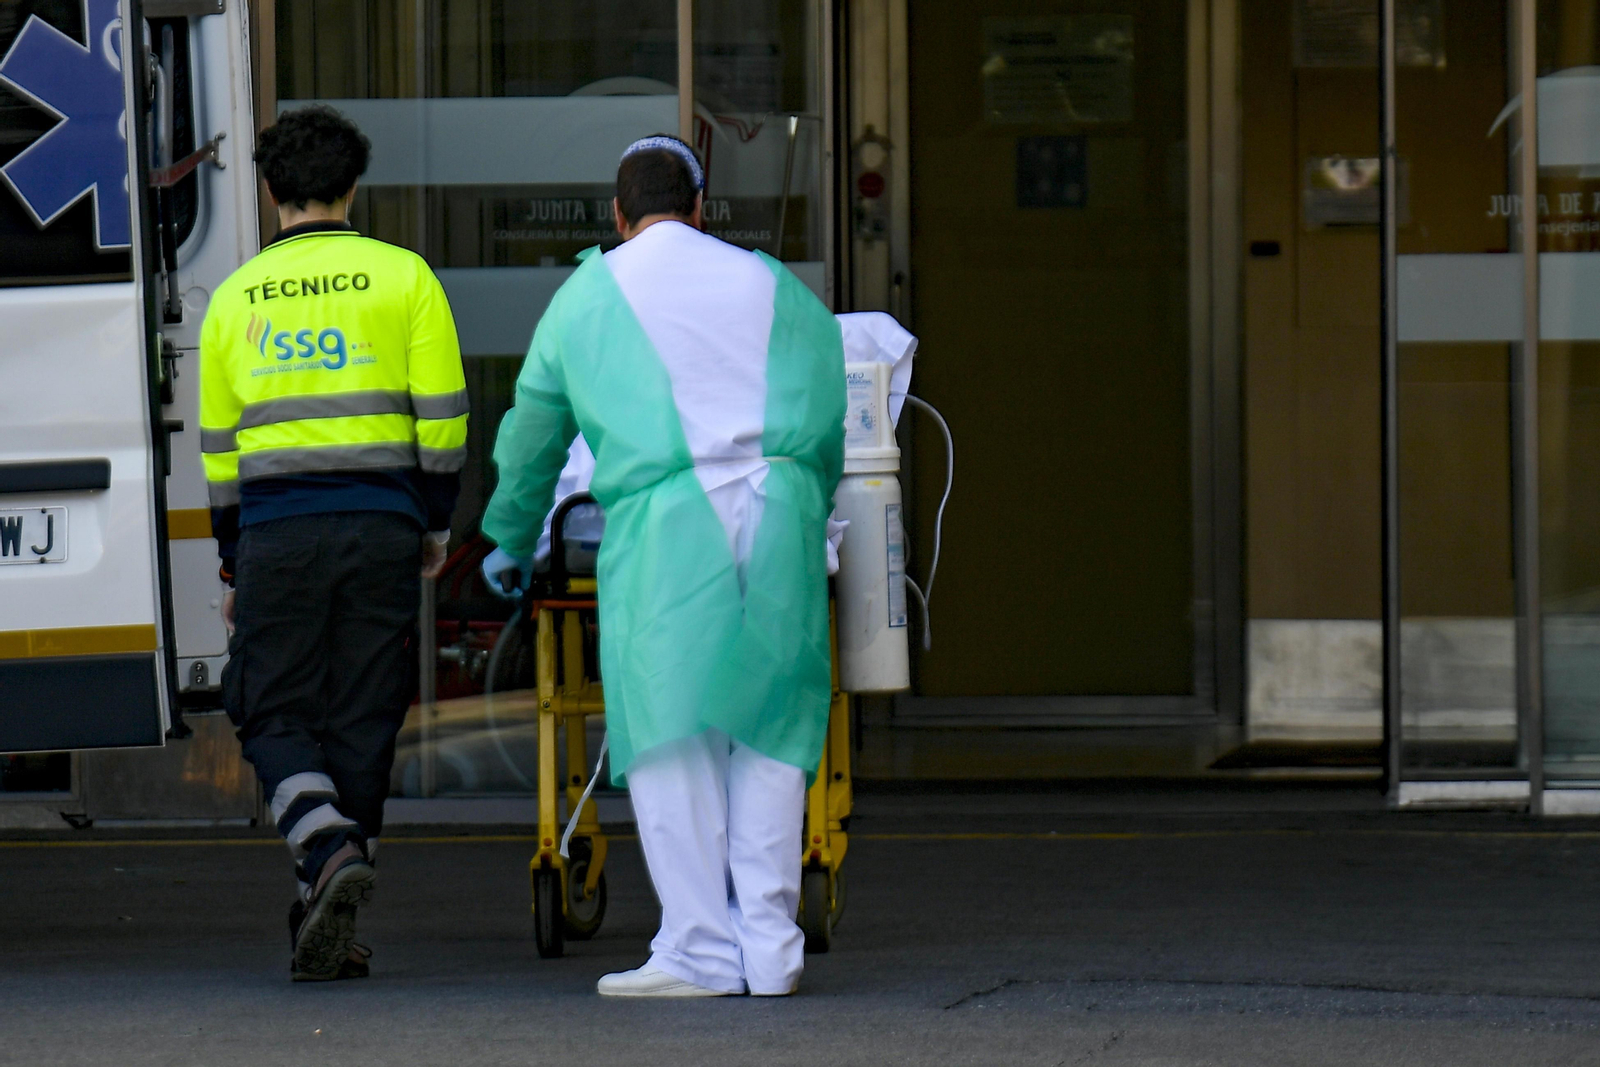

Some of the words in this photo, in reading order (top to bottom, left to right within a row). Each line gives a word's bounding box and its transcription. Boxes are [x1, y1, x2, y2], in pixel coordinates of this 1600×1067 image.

[526, 199, 587, 221] JUNTA
[1486, 194, 1550, 216] JUNA
[1559, 192, 1583, 214] DE
[556, 229, 570, 240] DE
[572, 229, 619, 240] IGUALDA
[725, 230, 771, 239] SOCIALES
[244, 272, 371, 304] TÉCNICO
[273, 327, 348, 370] ssg
